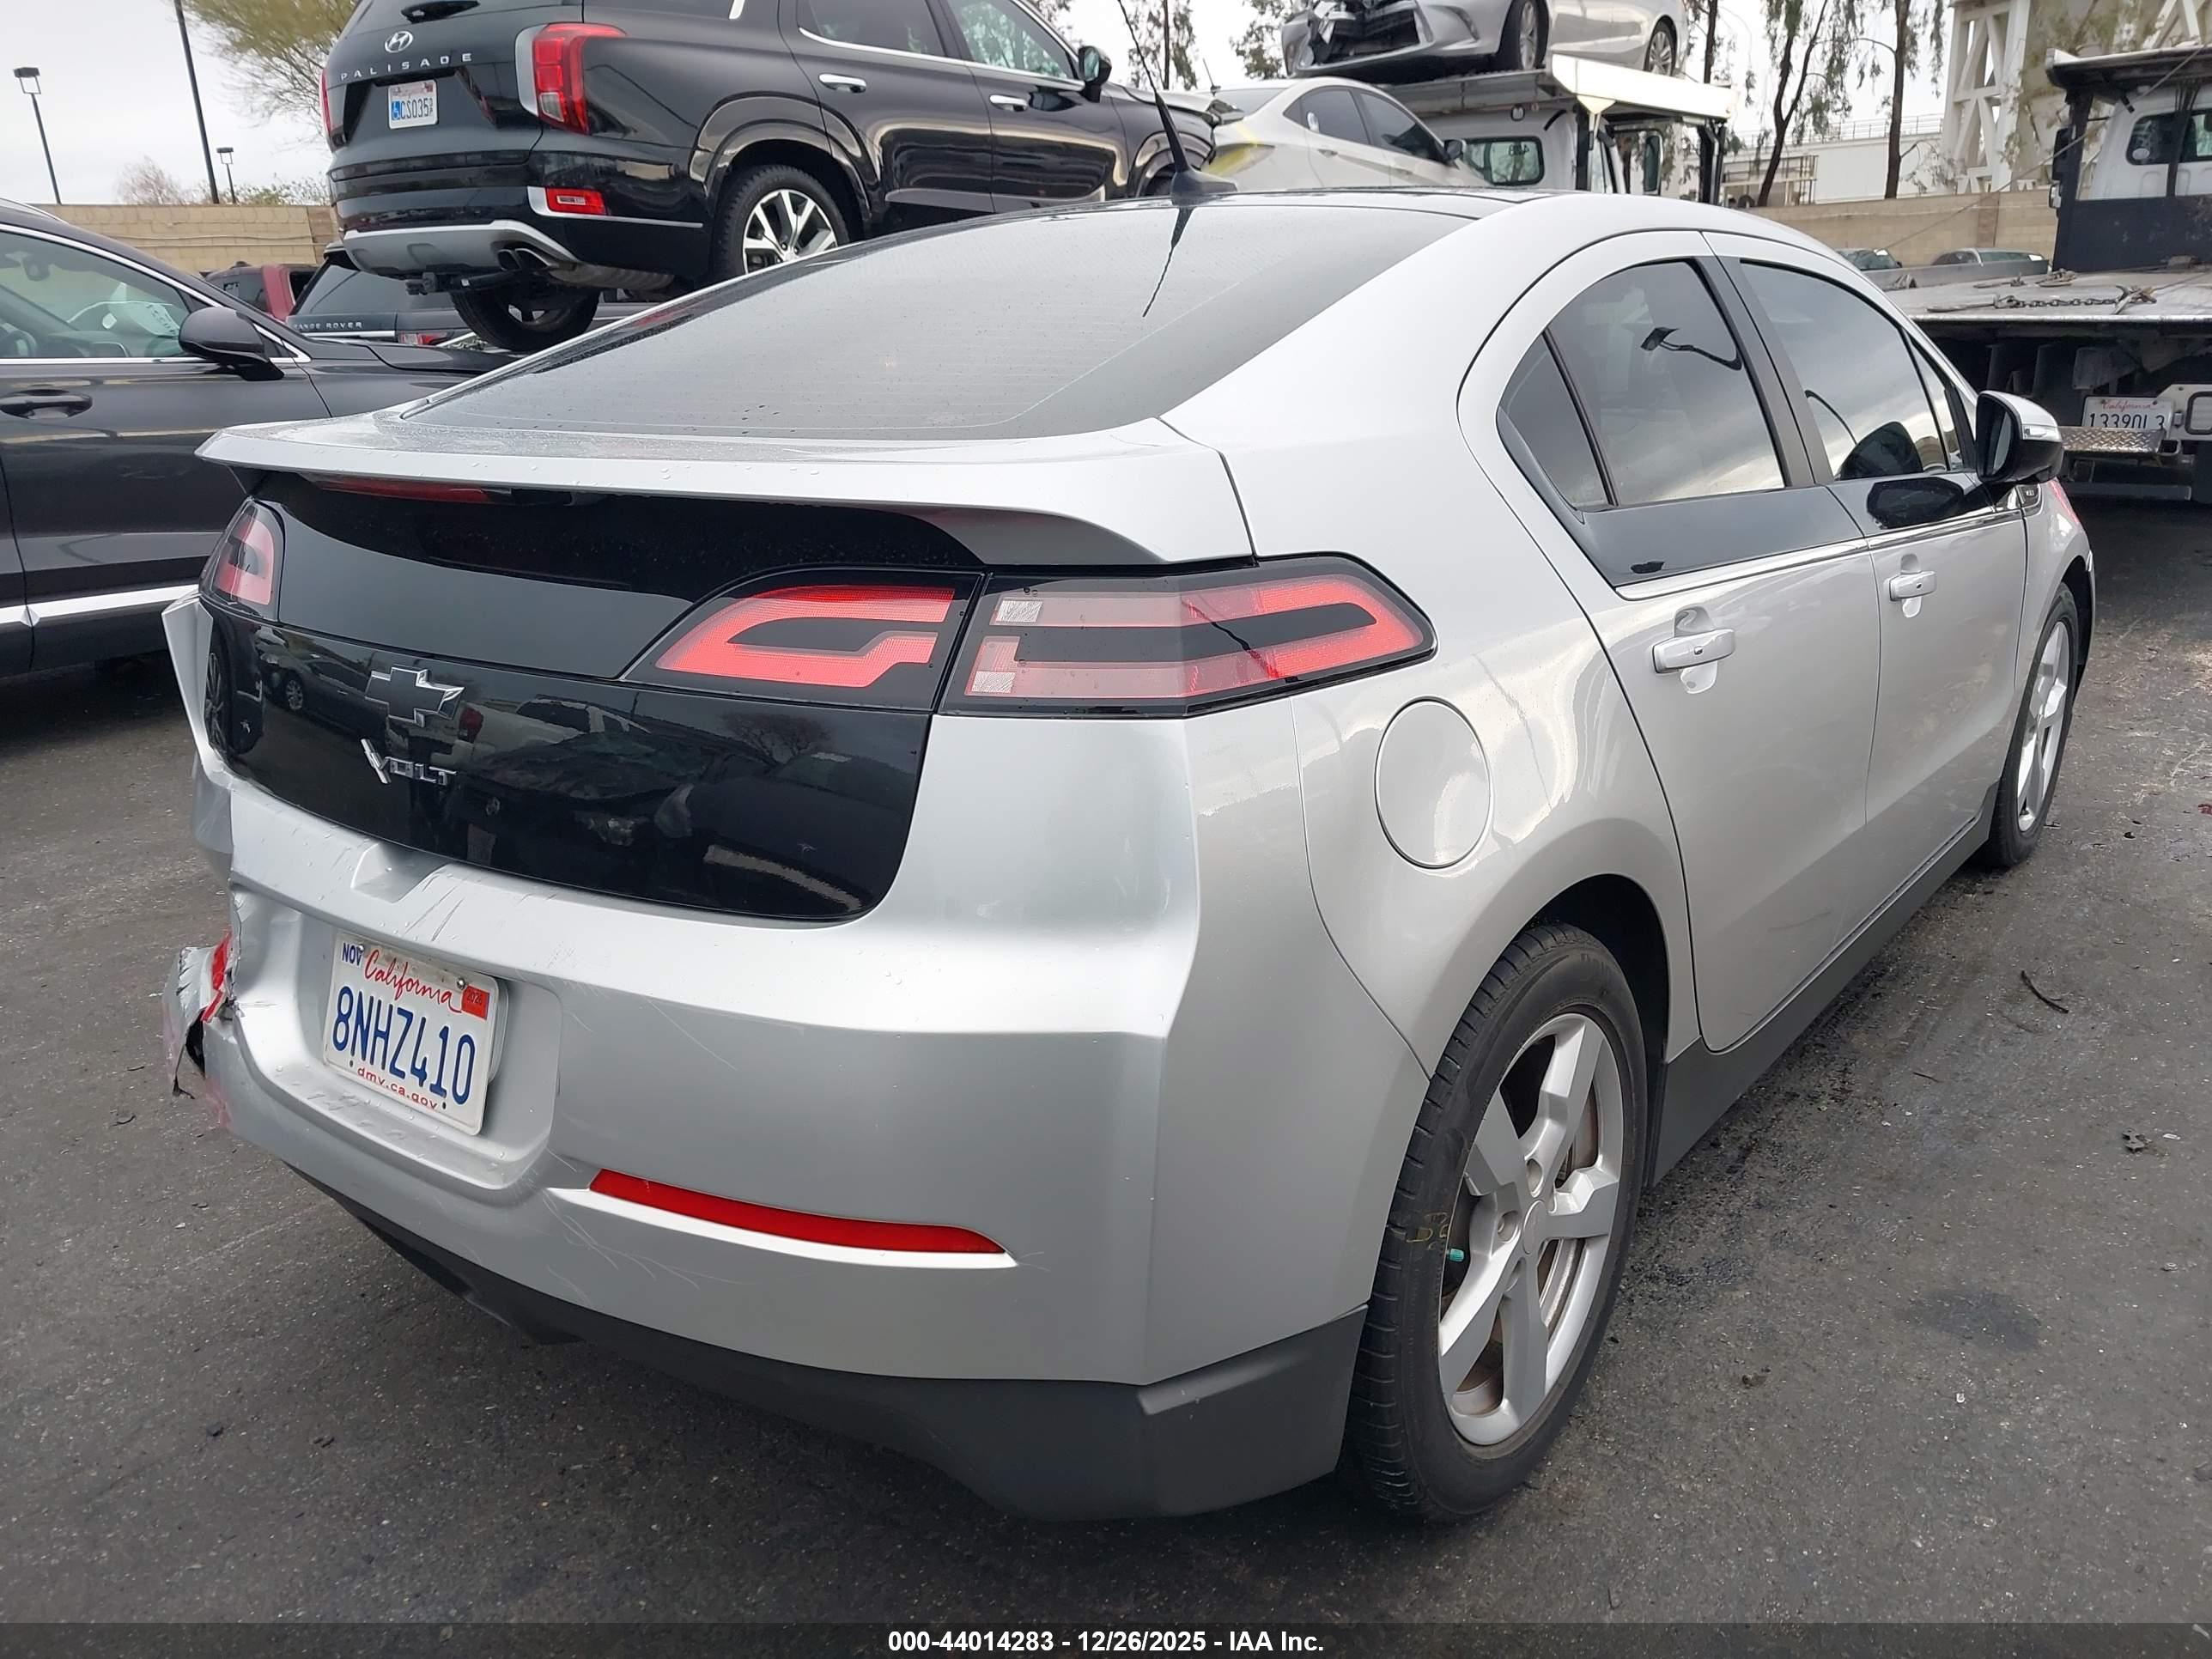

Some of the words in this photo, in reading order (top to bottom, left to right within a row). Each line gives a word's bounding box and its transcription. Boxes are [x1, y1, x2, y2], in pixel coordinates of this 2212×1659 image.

[340, 52, 472, 81] PALISADE
[400, 97, 429, 119] CS035
[2102, 399, 2158, 412] California
[361, 738, 457, 785] VOLT
[342, 942, 364, 967] NOV
[364, 949, 462, 1014] California
[332, 985, 476, 1105] 8NHZ410
[357, 1066, 438, 1110] dmv.ca.gov
